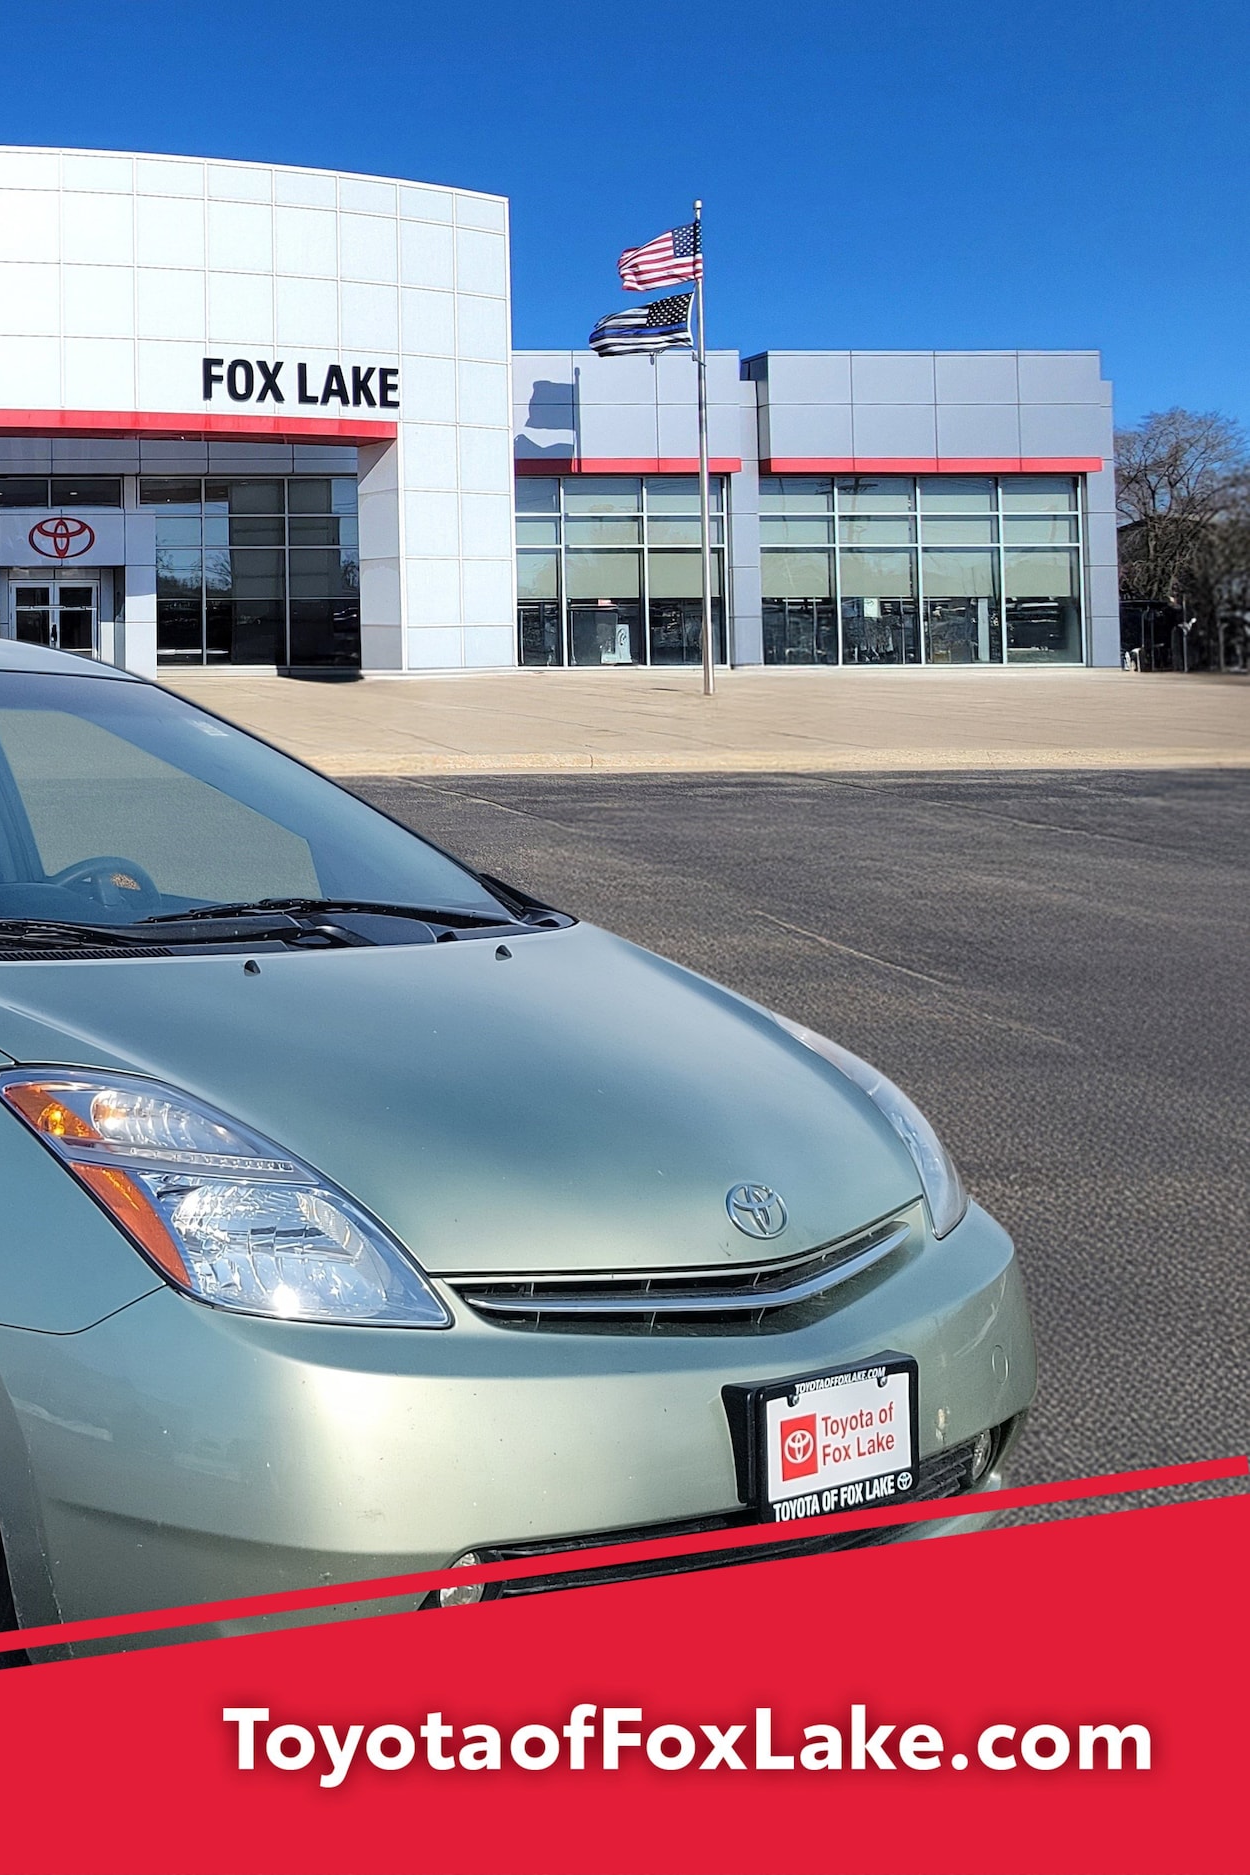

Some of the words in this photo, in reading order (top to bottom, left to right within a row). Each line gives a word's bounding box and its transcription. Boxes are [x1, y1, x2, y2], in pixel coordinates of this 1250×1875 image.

[203, 357, 285, 403] FOX
[297, 362, 400, 408] LAKE
[795, 1367, 886, 1394] TOYOTAOFFOXLAKE.COM
[821, 1409, 873, 1439] Toyota
[879, 1402, 894, 1424] of
[822, 1443, 852, 1466] Fox
[856, 1432, 895, 1457] Lake
[773, 1494, 820, 1523] TOYOTA
[822, 1491, 838, 1513] OF
[840, 1484, 864, 1507] FOX
[865, 1474, 895, 1500] LAKE
